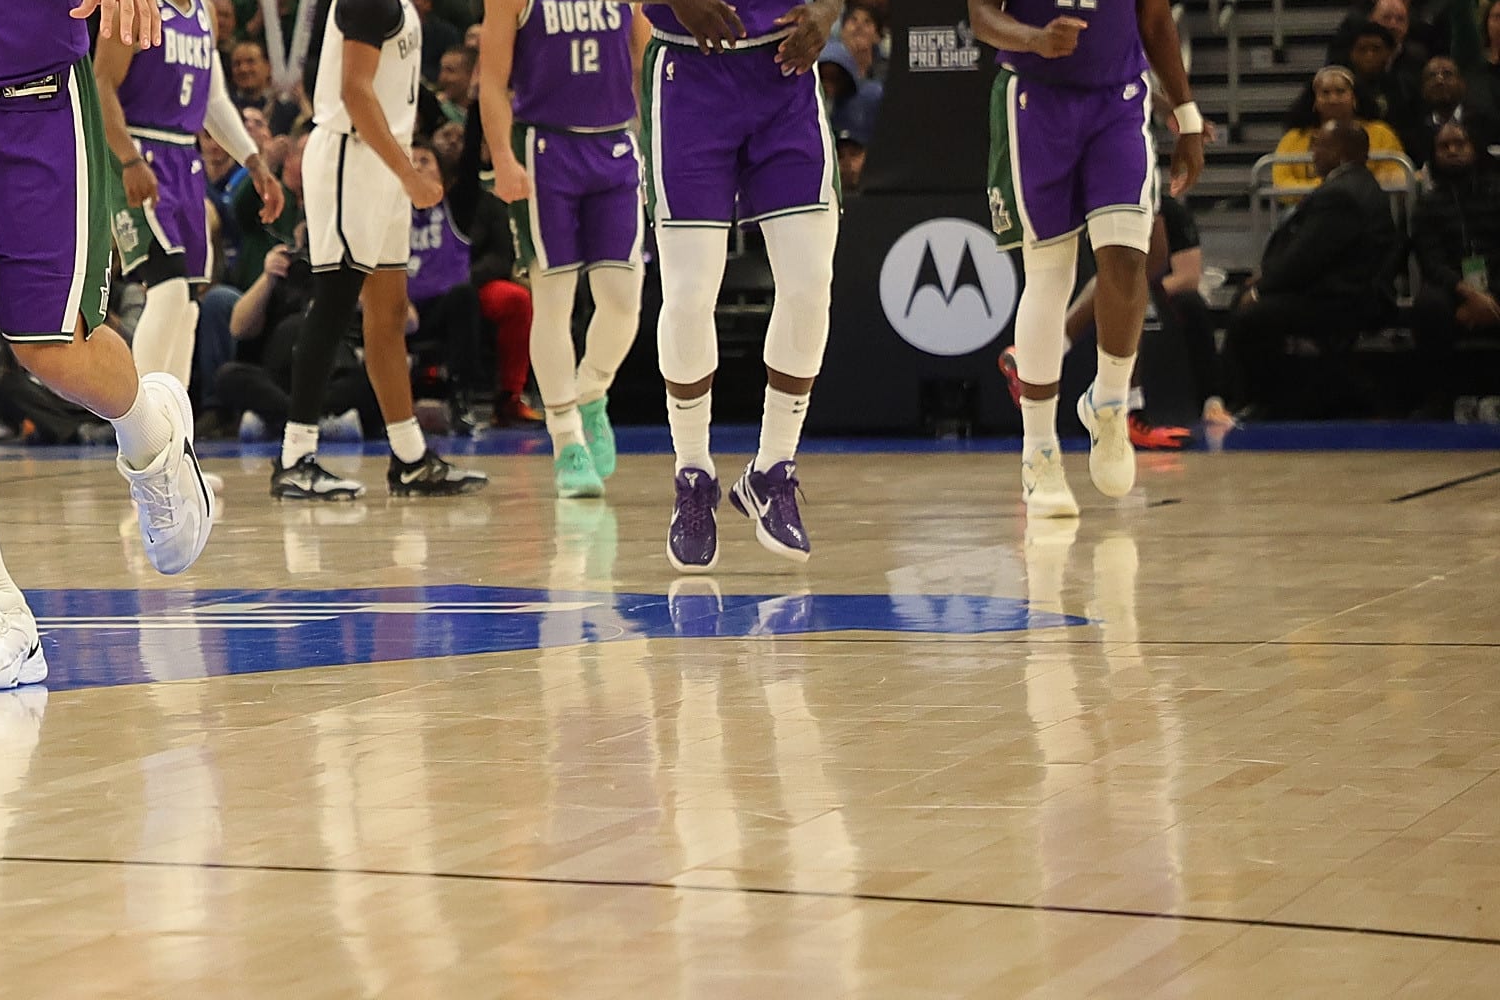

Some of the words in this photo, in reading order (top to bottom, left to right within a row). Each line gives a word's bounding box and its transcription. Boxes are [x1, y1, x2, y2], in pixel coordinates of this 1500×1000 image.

[163, 27, 211, 70] BUCKS
[570, 38, 601, 75] 12
[909, 31, 956, 50] BUCKS
[909, 50, 937, 67] PRO
[940, 48, 980, 68] SHOP
[179, 72, 196, 107] 5
